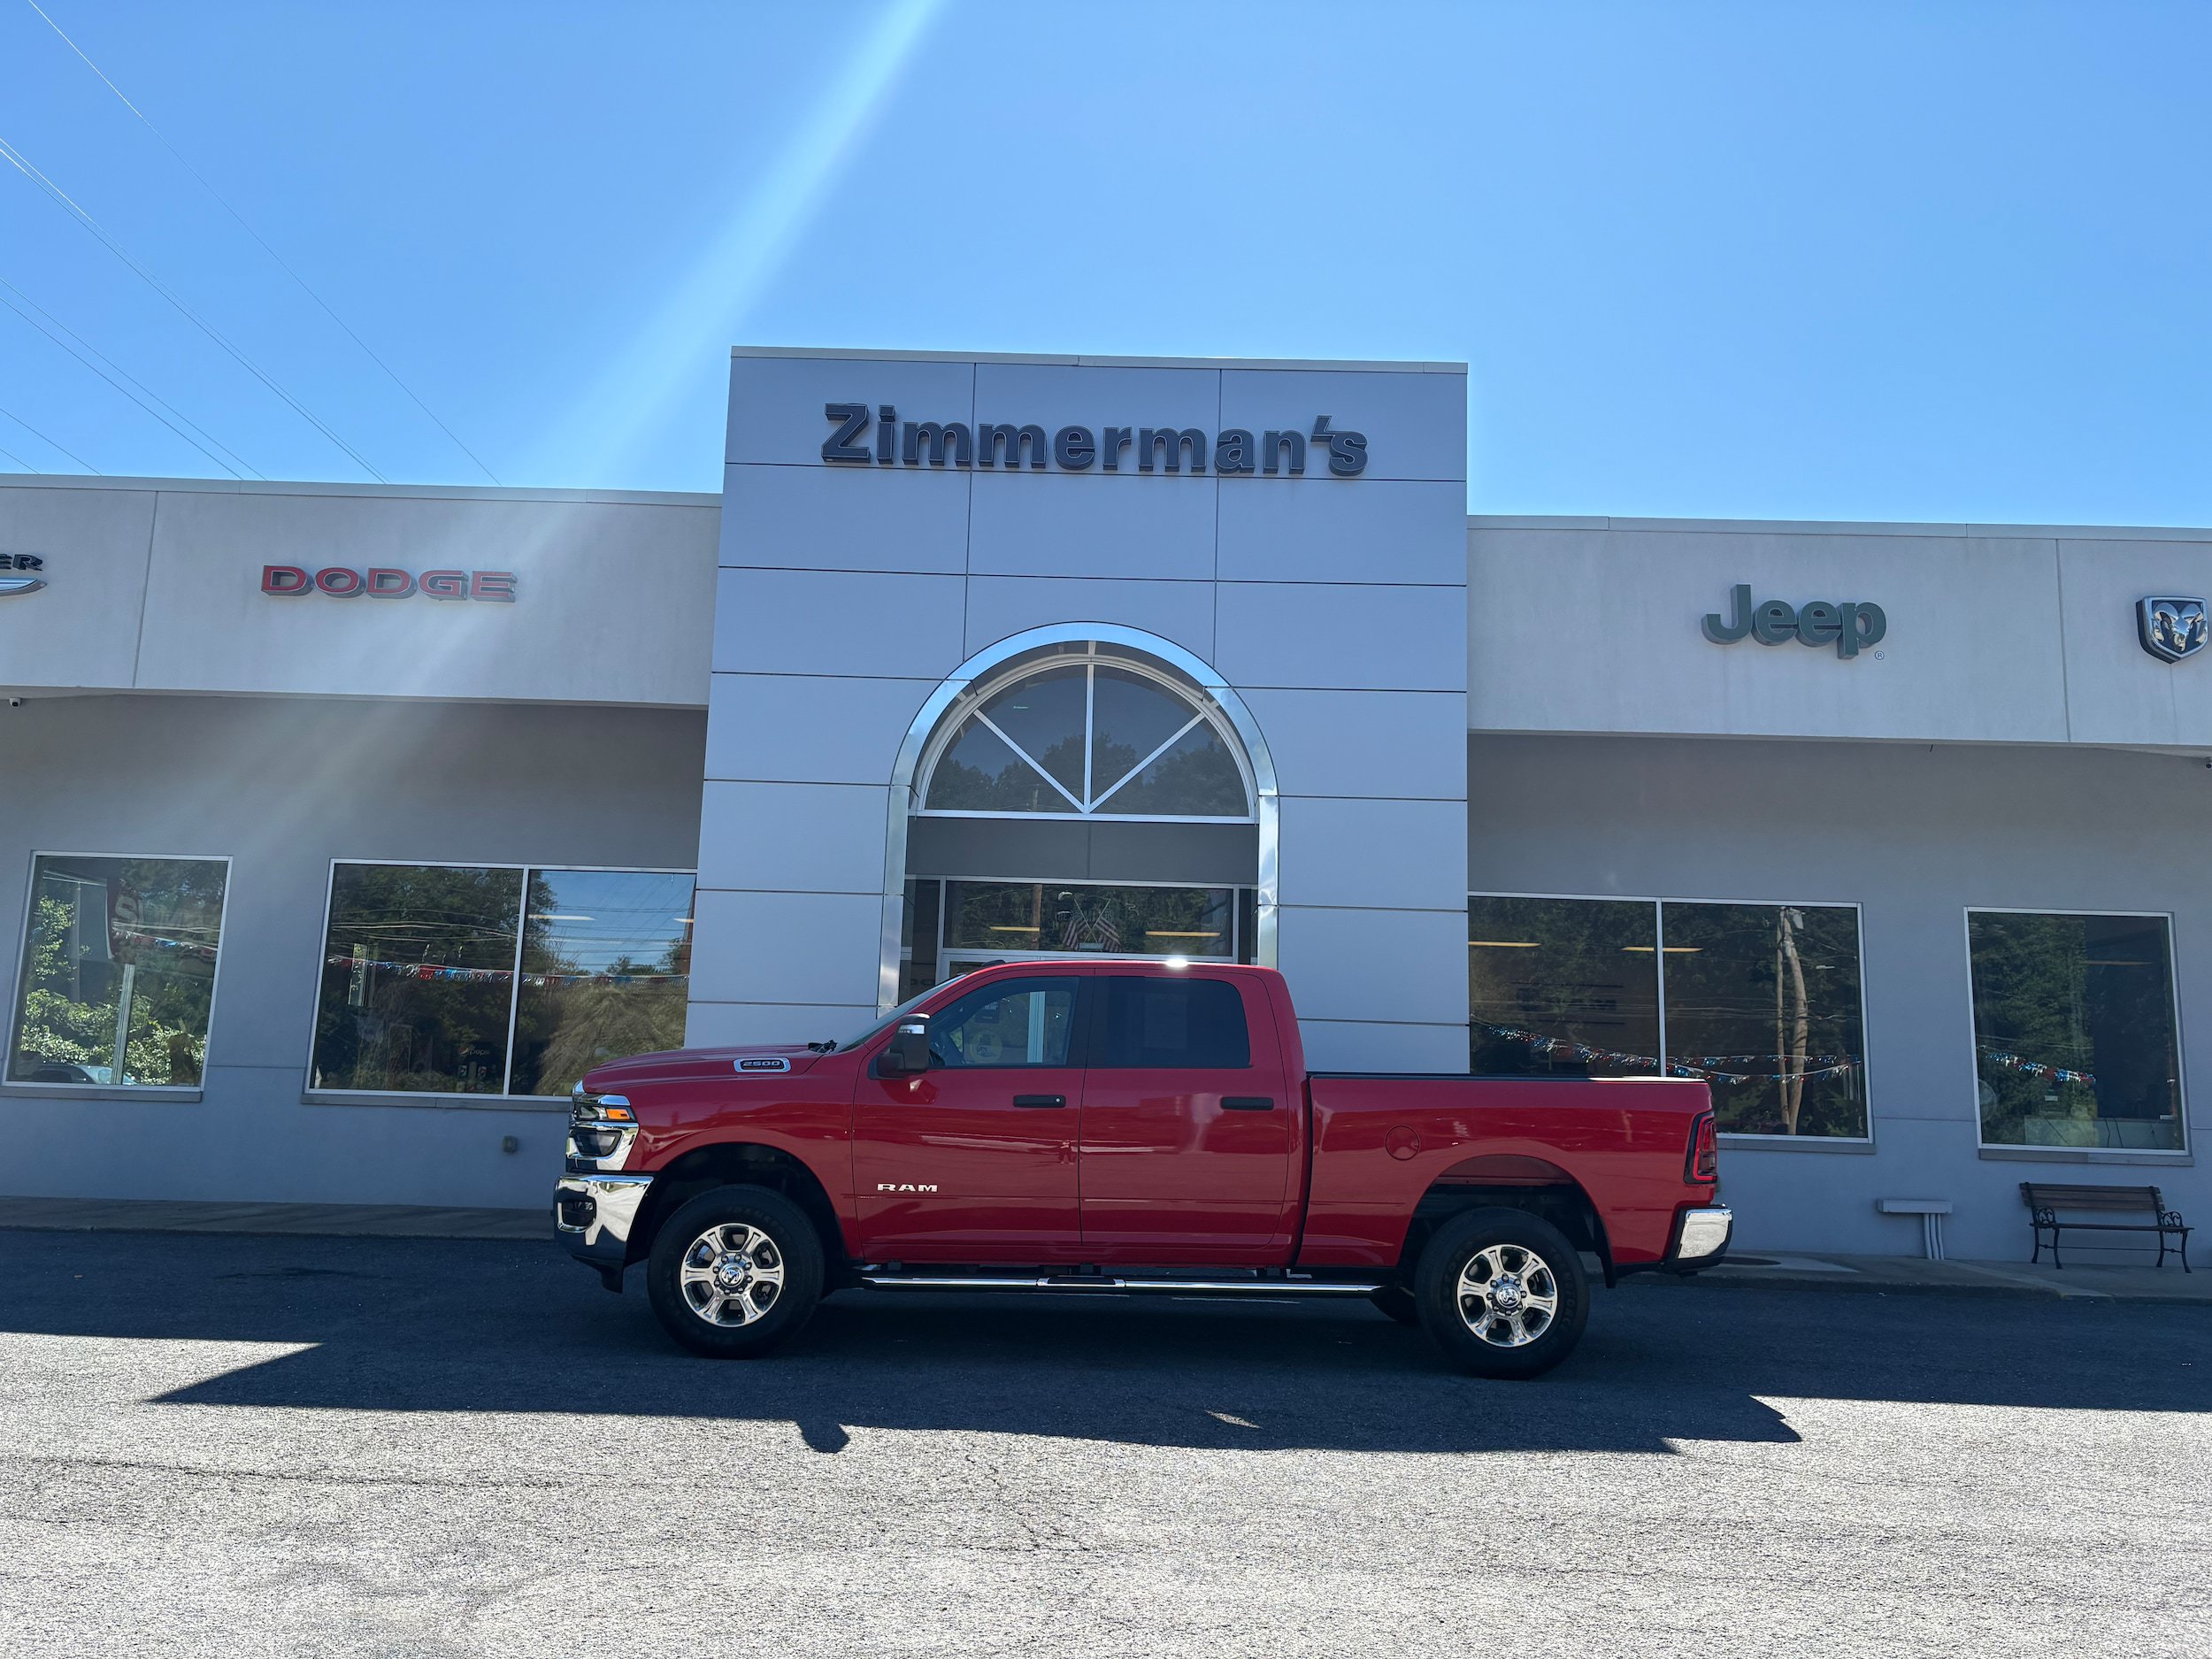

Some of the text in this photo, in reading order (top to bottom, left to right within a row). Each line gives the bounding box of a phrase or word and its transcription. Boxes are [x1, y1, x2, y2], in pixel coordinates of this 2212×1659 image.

[821, 403, 1368, 476] Zimmerman's
[261, 565, 518, 603] DODGE
[1701, 583, 1887, 660] Jeep
[877, 1183, 938, 1193] RAM
